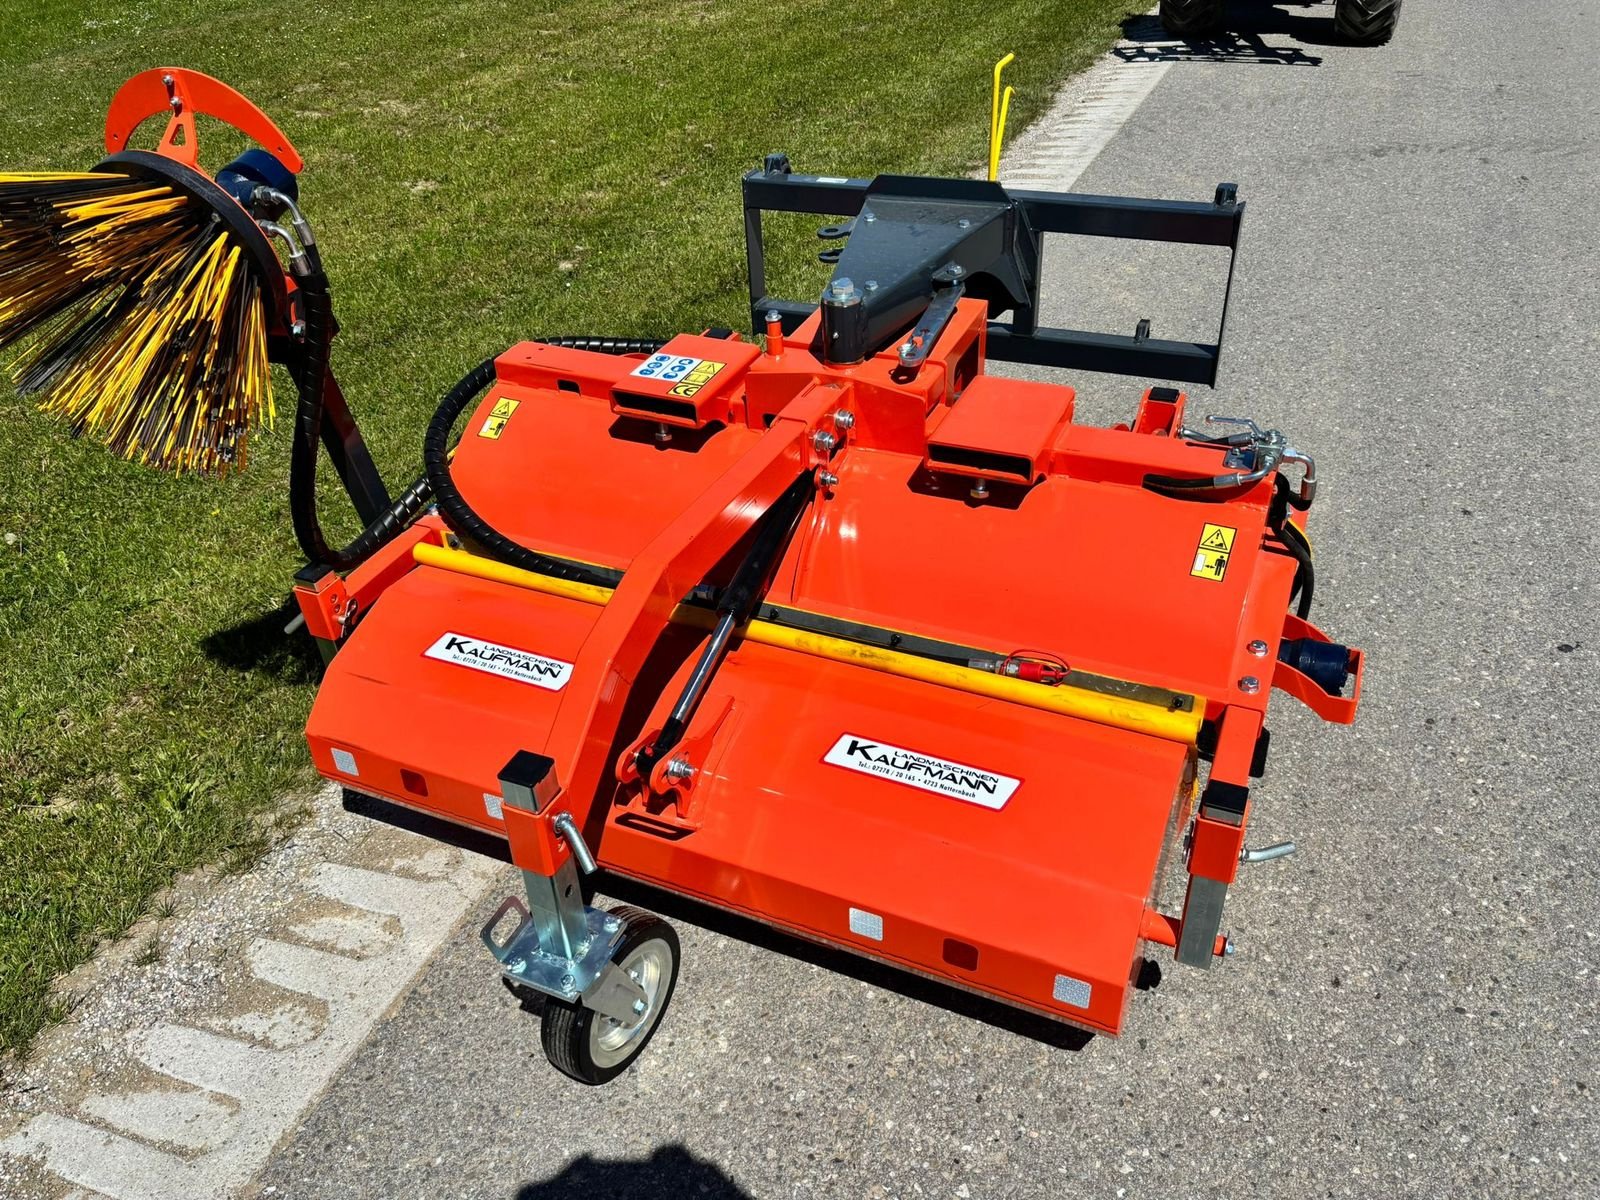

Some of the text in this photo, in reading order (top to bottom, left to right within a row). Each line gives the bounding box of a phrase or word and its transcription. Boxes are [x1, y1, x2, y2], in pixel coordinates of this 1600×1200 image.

[673, 384, 699, 396] CE
[445, 636, 561, 679] KAUFMANN
[484, 644, 565, 669] LANDMASCHINEN
[846, 739, 997, 795] KAUFMANN
[858, 760, 870, 769] Tel.:
[872, 764, 890, 775] 07278
[905, 773, 916, 782] 165
[923, 779, 938, 788] 4723
[939, 783, 976, 798] Natternbach
[894, 750, 999, 784] LANDMASCHINEN
